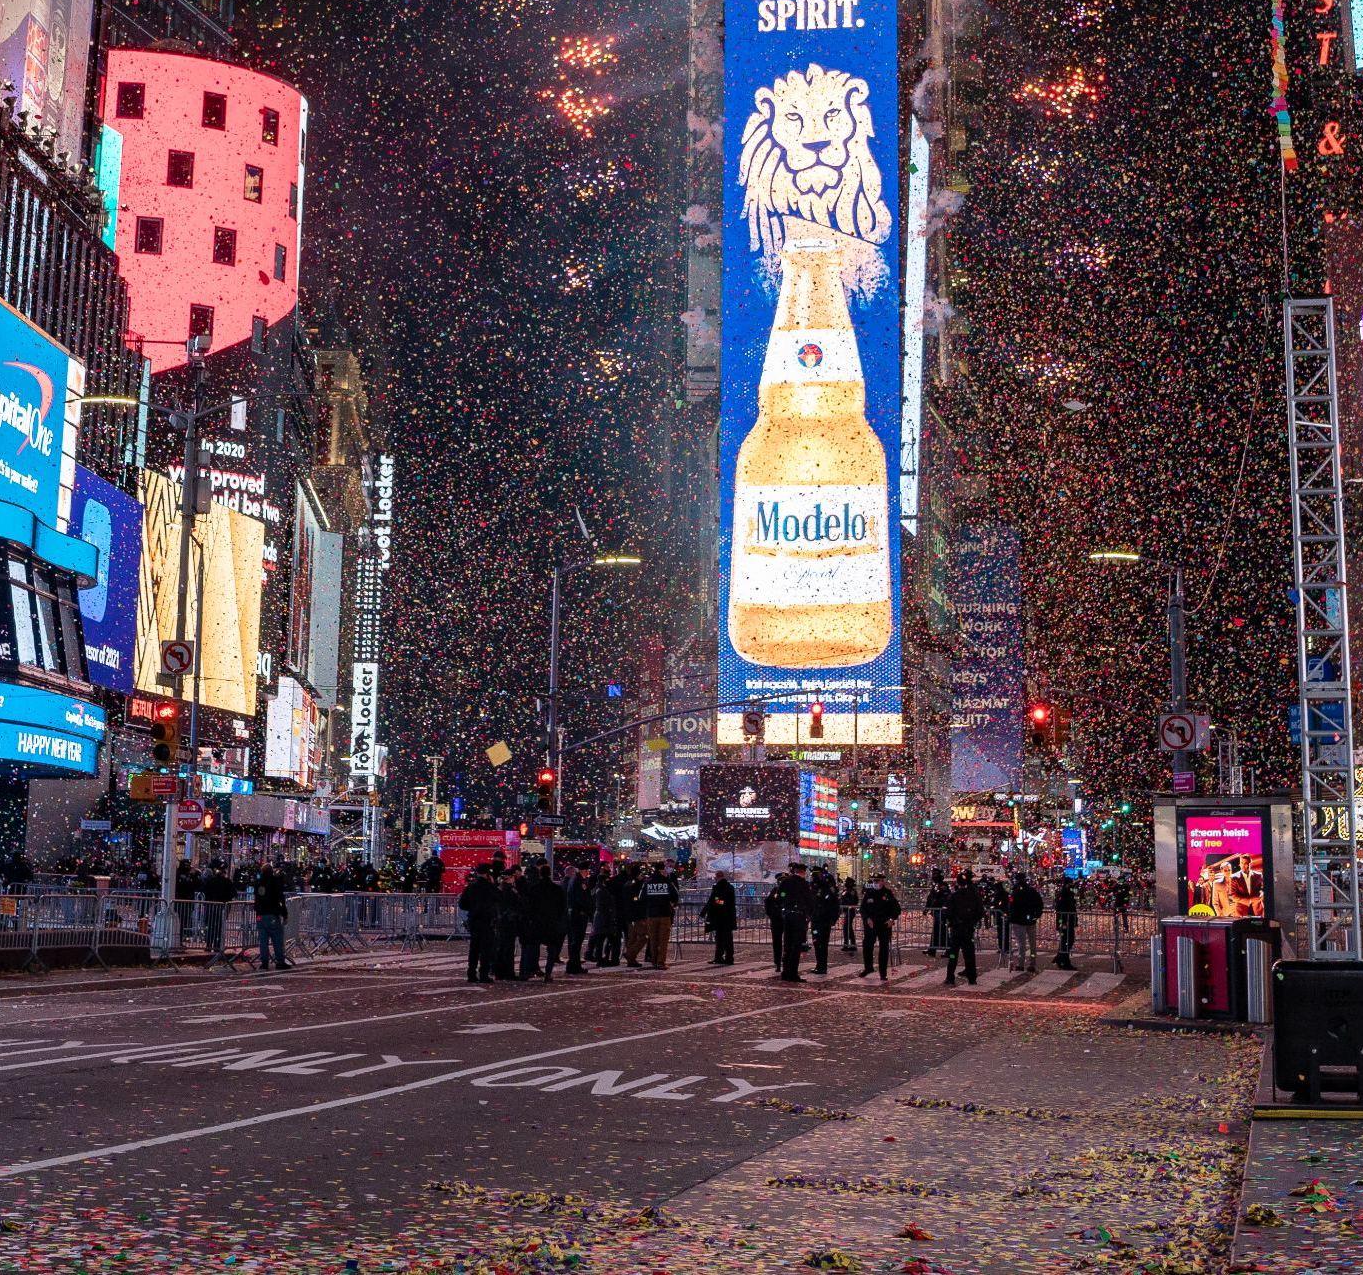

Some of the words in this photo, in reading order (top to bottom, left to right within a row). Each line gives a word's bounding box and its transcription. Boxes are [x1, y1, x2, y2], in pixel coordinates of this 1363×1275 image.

[1319, 121, 1346, 155] &
[215, 441, 246, 459] 2020
[210, 468, 266, 496] proved
[373, 453, 395, 522] Locker
[241, 491, 261, 517] be
[262, 498, 280, 523] two
[756, 501, 866, 543] Modelo
[356, 667, 375, 727] Locker
[17, 732, 51, 757] HAPPY
[726, 807, 770, 816] MARINES
[1190, 828, 1222, 838] stream
[1222, 827, 1250, 838] heists
[1190, 838, 1204, 849] for
[1204, 839, 1223, 849] free
[469, 1066, 817, 1104] ONLY
